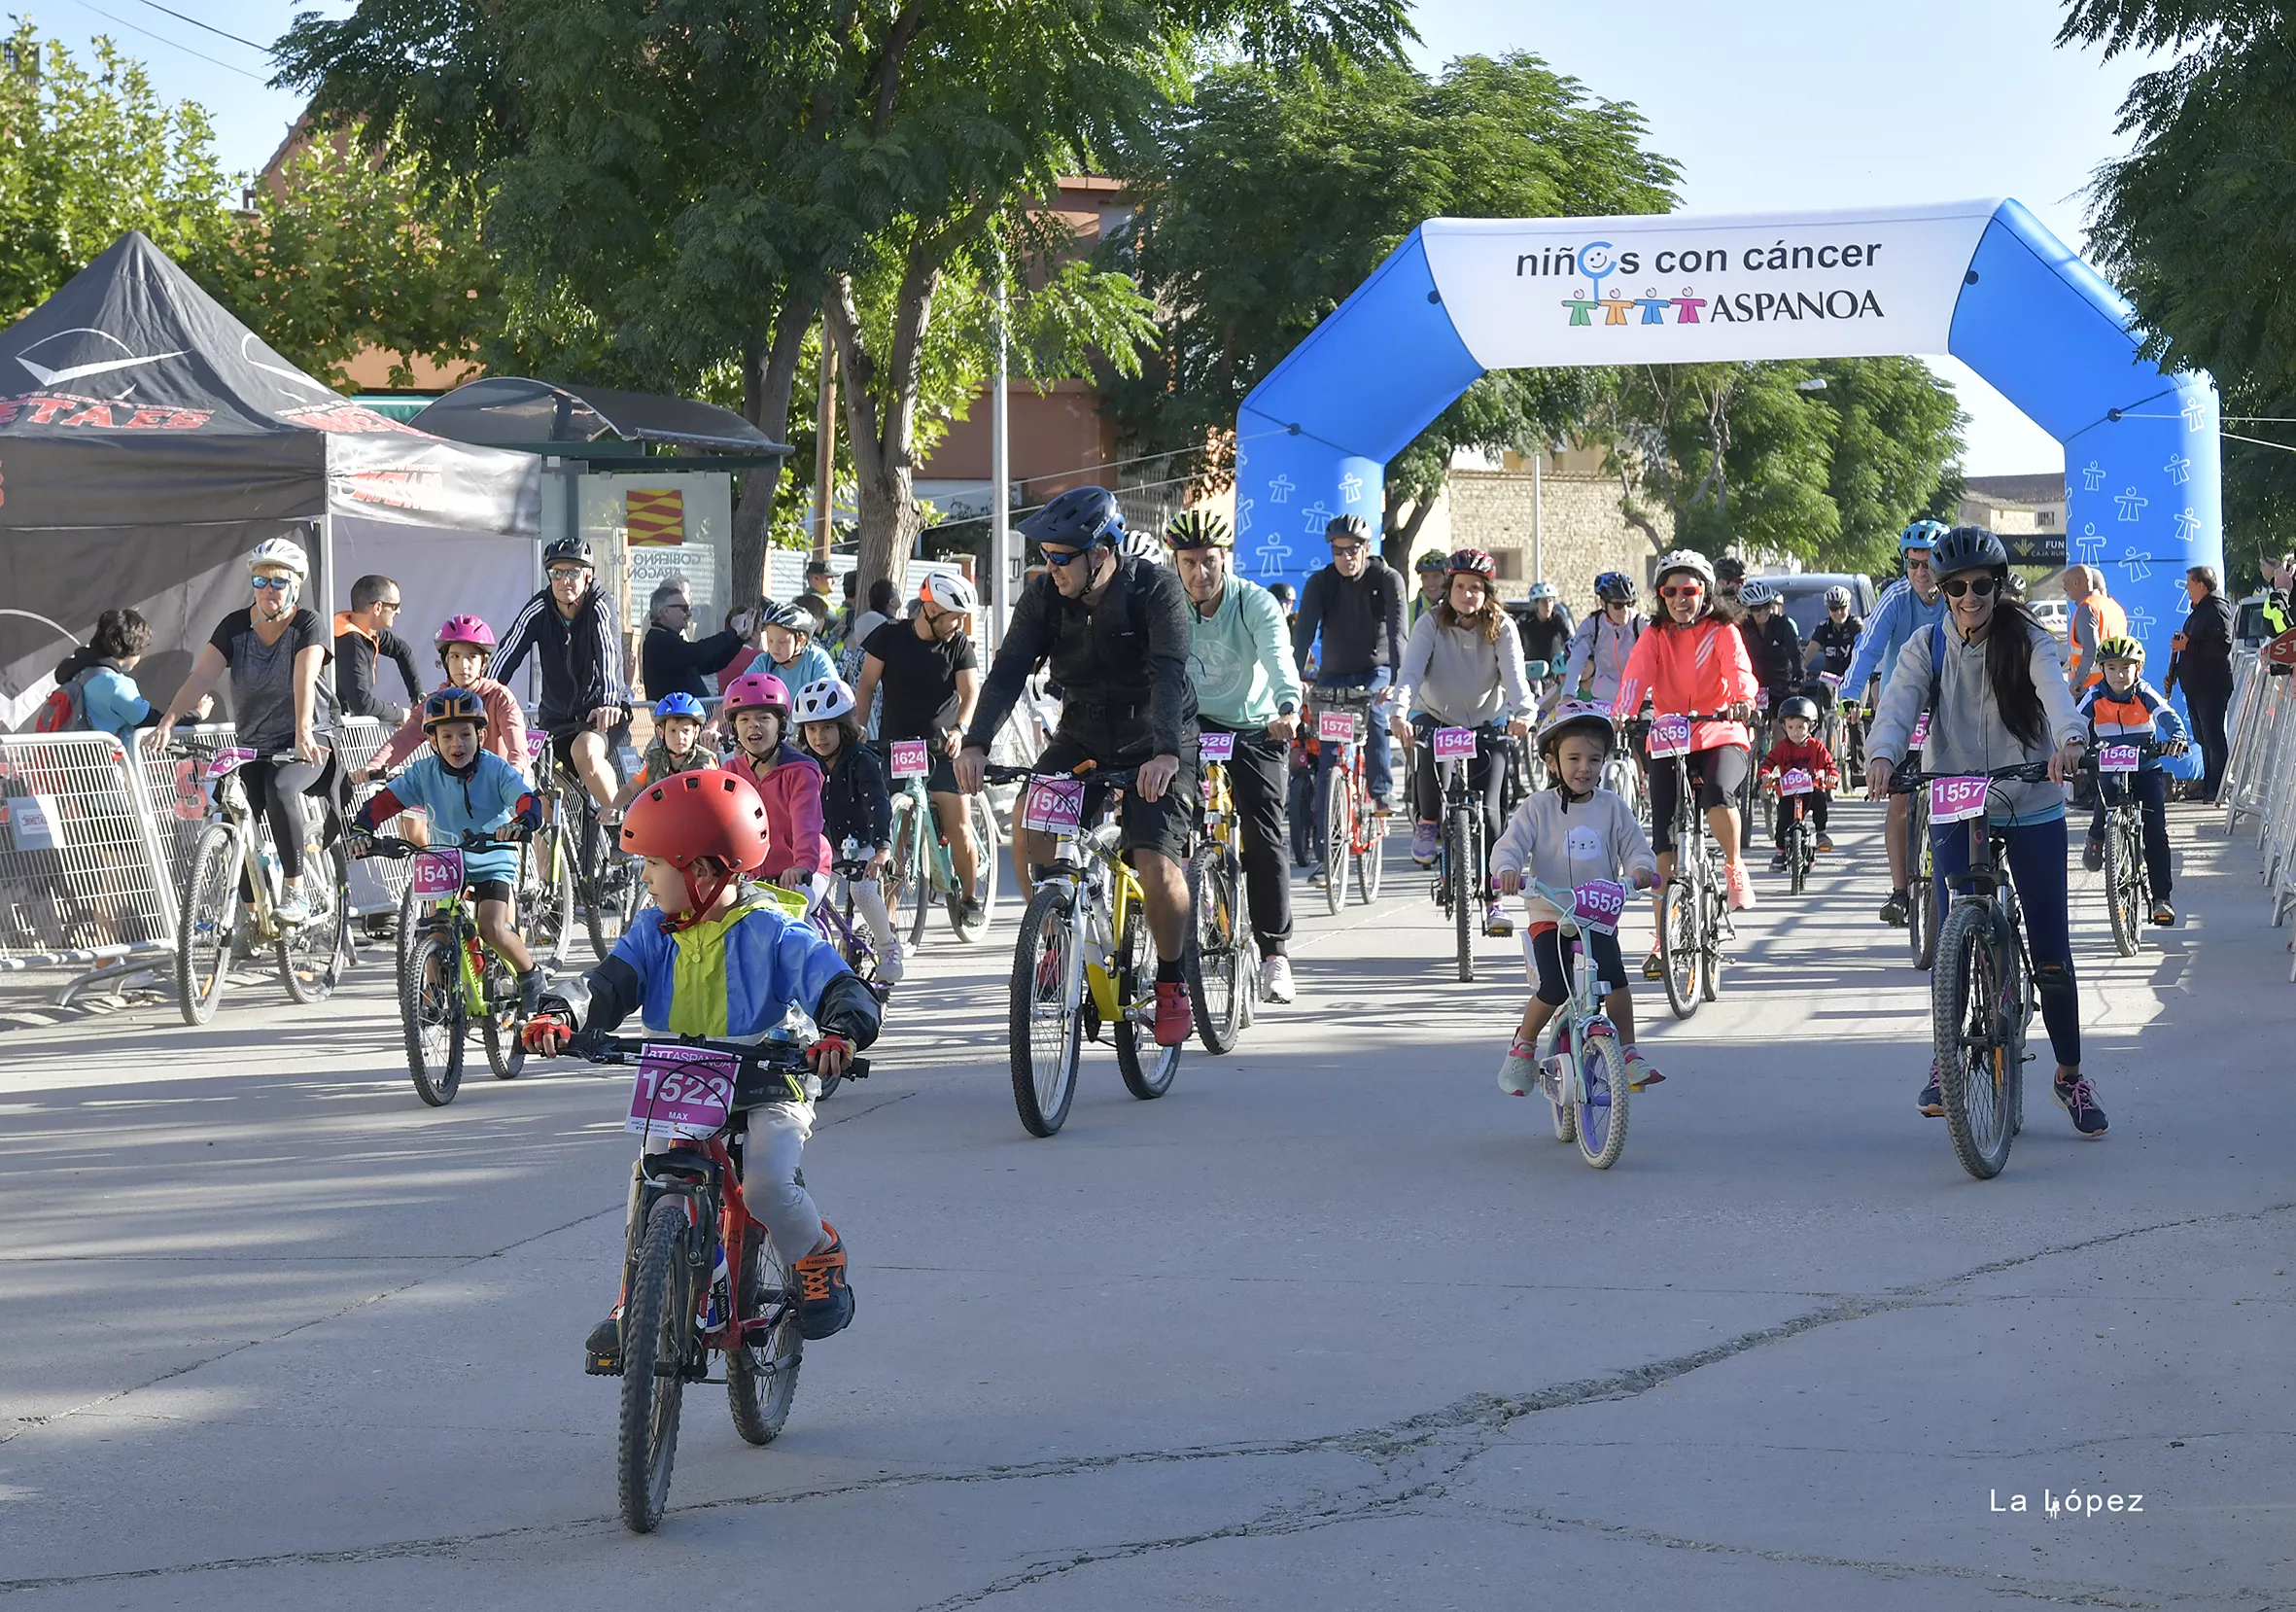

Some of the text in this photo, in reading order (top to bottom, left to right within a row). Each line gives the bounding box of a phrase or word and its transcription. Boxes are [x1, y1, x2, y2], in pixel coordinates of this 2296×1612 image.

[1655, 248, 1727, 273] con
[1743, 239, 1882, 271] cáncer
[1710, 290, 1885, 322] ASPANOA
[2045, 541, 2065, 549] FUN
[1323, 720, 1352, 733] 1573
[1652, 725, 1687, 743] 1659
[1437, 734, 1473, 748] 1542
[893, 751, 924, 765] 1624
[2105, 749, 2136, 759] 1546
[1934, 782, 1986, 803] 1557
[416, 862, 458, 883] 1541
[1577, 889, 1622, 916] 1558
[643, 1069, 728, 1107] 1522
[668, 1111, 688, 1120] MAX
[806, 1256, 836, 1266] HEAD
